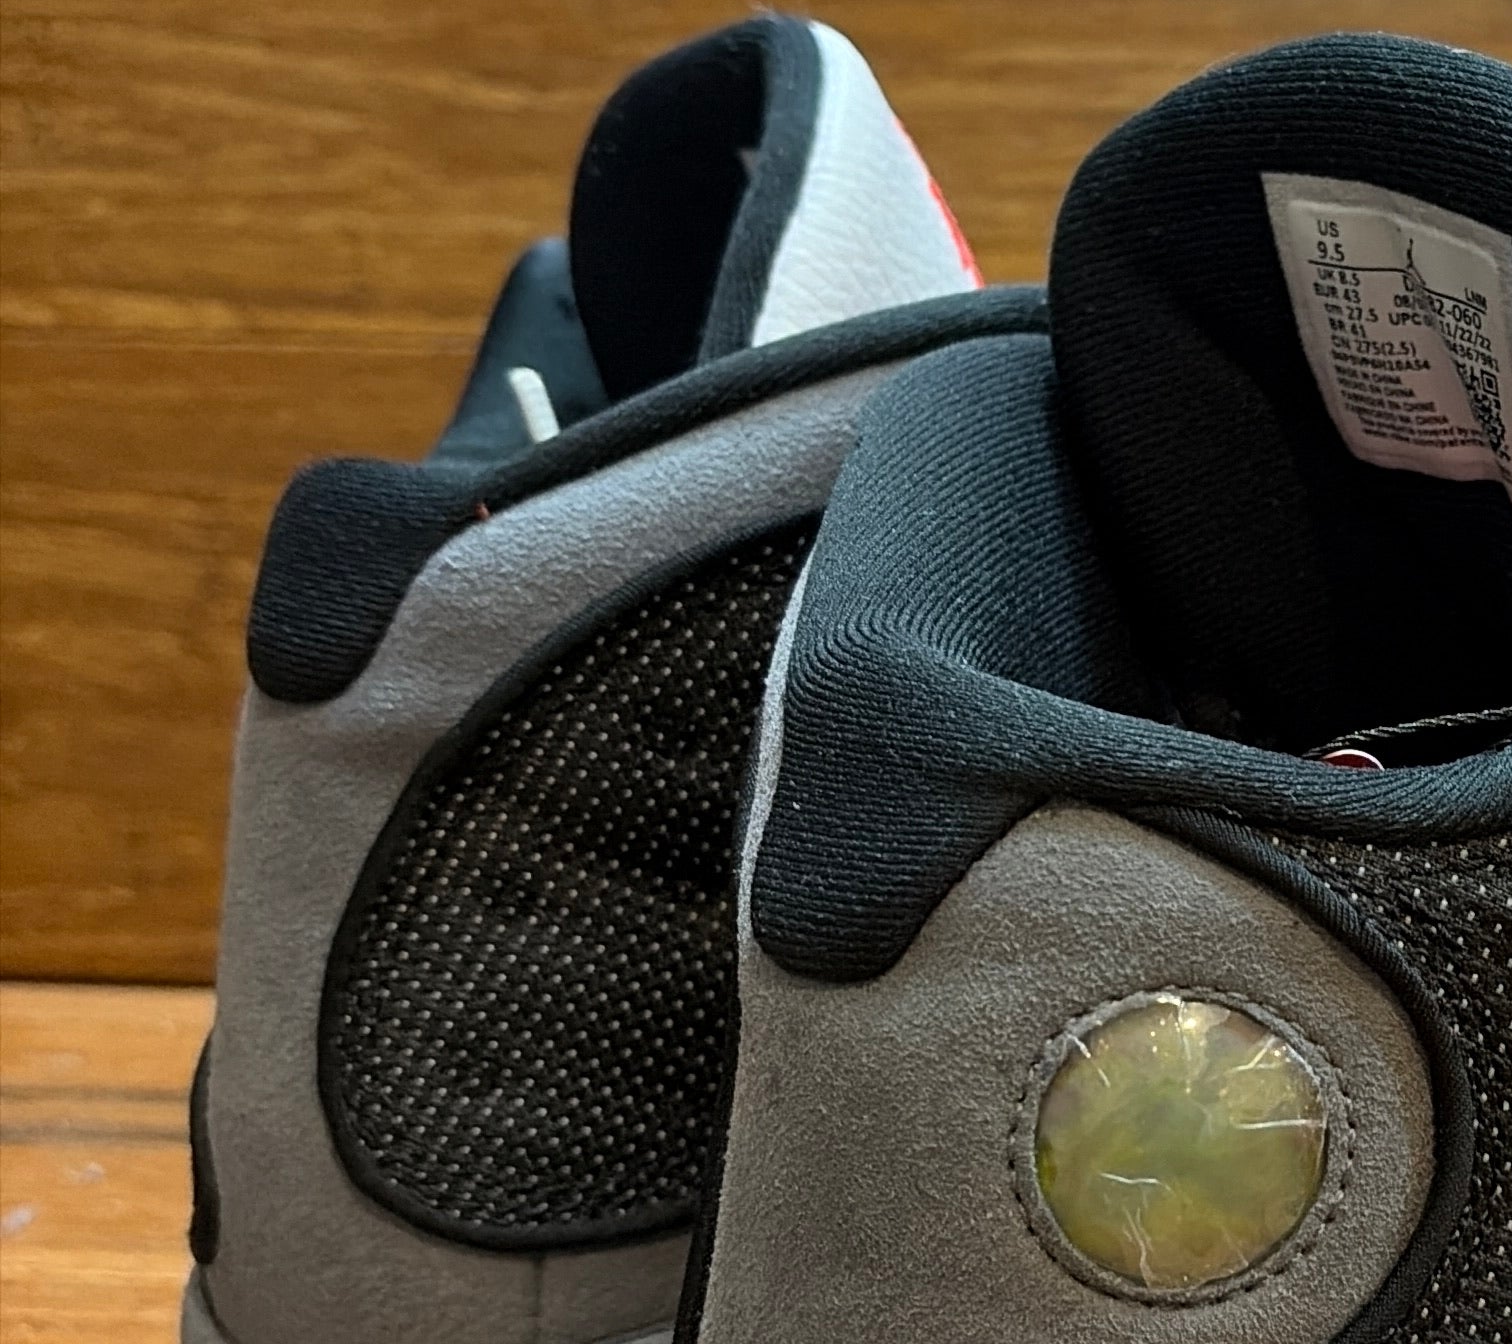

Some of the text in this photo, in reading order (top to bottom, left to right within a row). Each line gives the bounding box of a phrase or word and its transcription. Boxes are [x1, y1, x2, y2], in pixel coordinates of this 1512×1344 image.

[1317, 219, 1339, 238] US
[1317, 241, 1345, 262] 9.5
[1347, 306, 1379, 323] 27.5
